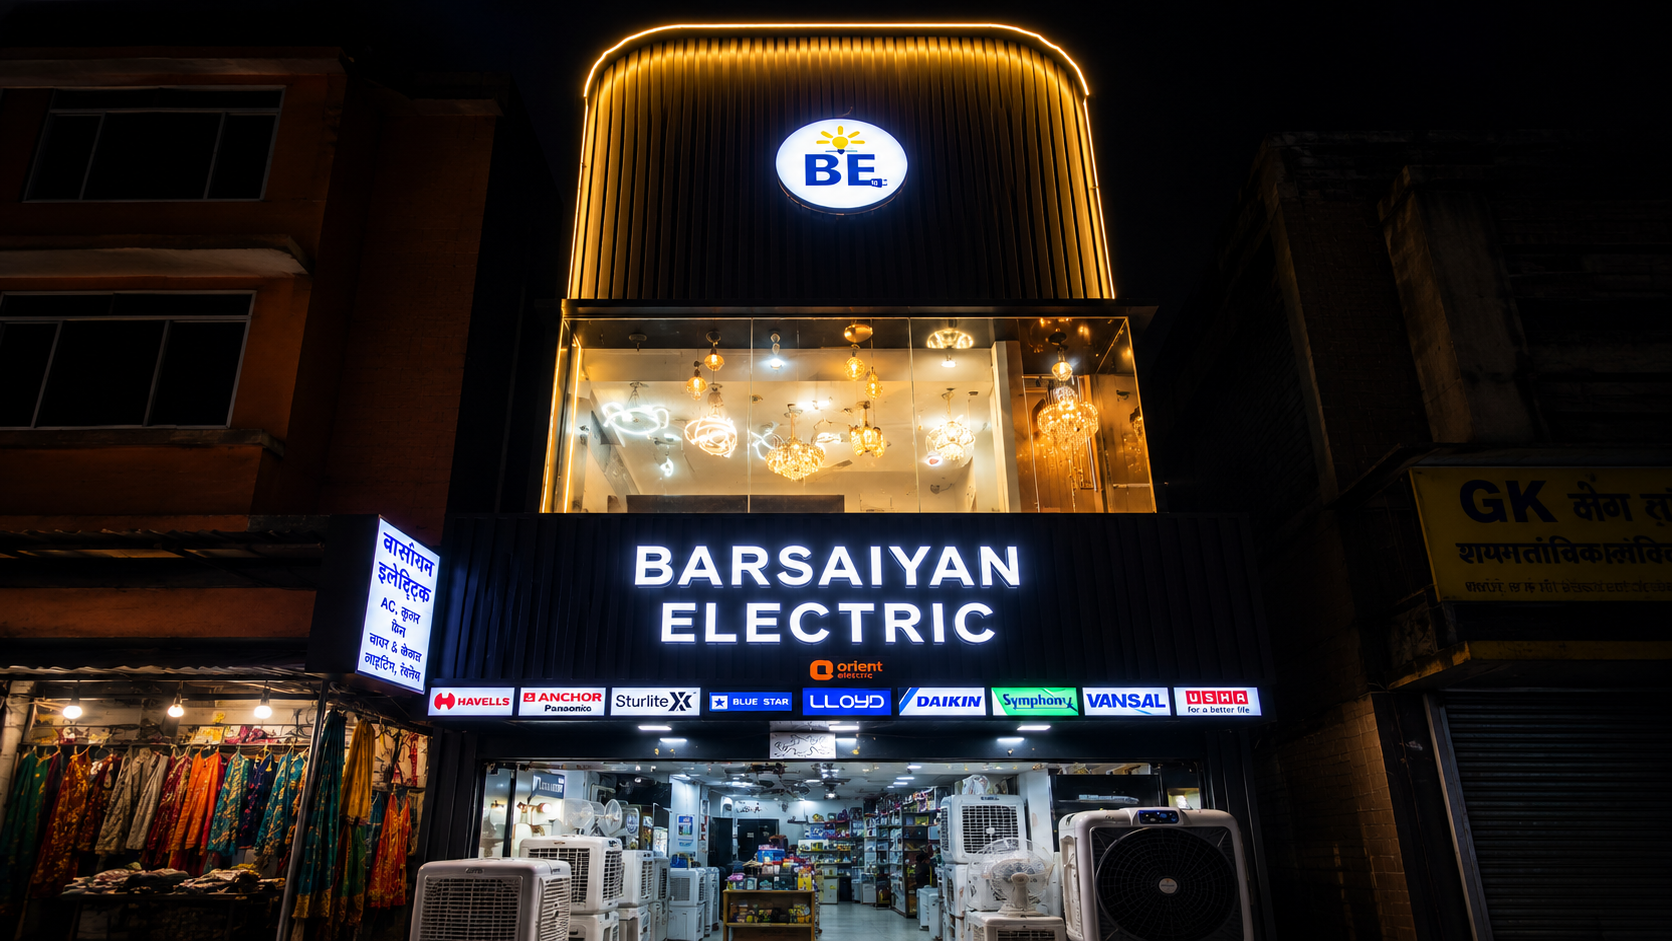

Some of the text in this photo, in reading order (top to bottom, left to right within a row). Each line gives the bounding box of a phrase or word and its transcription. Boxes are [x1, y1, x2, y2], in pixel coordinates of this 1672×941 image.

[805, 154, 875, 186] BE
[1459, 479, 1559, 523] GK
[634, 545, 1021, 587] BARSAIYAN
[660, 602, 996, 644] ELECTRIC
[391, 641, 398, 654] &
[837, 660, 884, 672] orient
[457, 697, 510, 706] HAVELLS
[538, 692, 602, 702] ANCHOR
[733, 698, 789, 706] BLUE STAR
[810, 694, 884, 709] LLOYD
[916, 696, 982, 708] DAIKIN
[1003, 693, 1074, 710] Symphony
[1086, 693, 1166, 708] VANSAL
[1188, 692, 1247, 703] USHA
[1187, 705, 1200, 713] for
[1210, 705, 1234, 713] better
